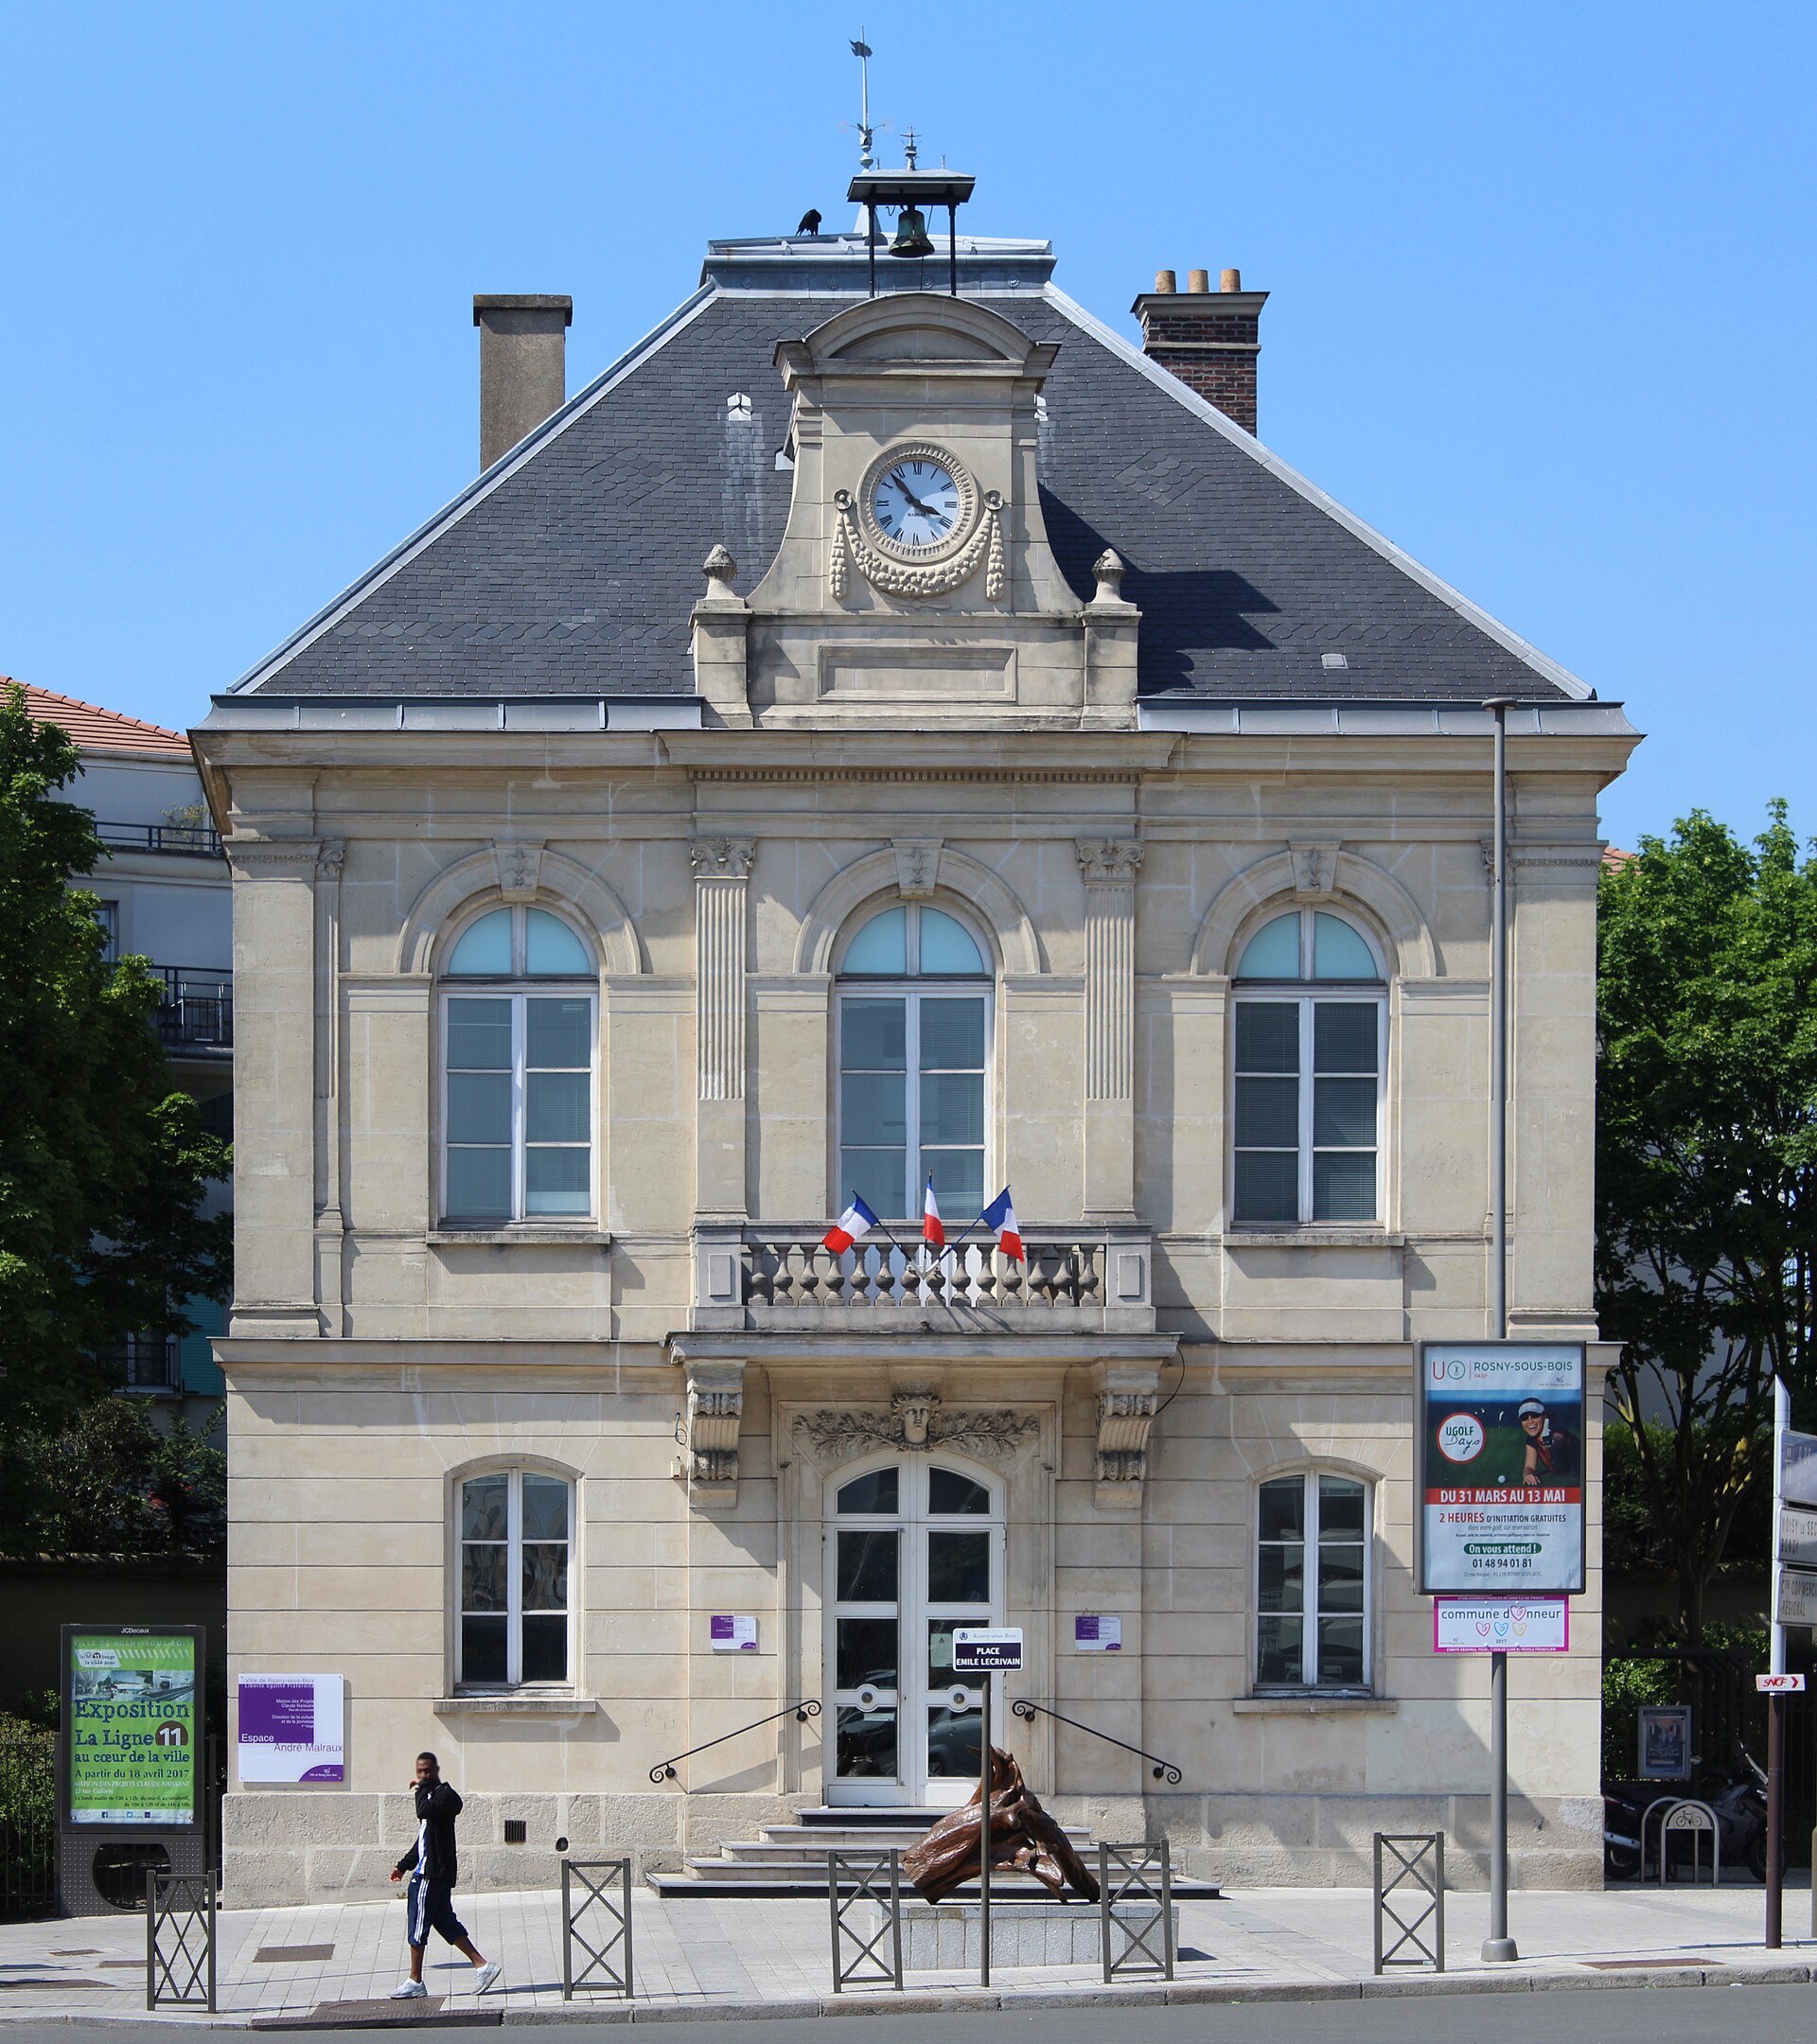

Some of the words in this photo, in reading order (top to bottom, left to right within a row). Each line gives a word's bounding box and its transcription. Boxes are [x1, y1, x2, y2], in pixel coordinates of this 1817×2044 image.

[1473, 1362, 1573, 1371] ROSNY-SOUS-BOIS
[1446, 1426, 1474, 1436] UGOLF
[1445, 1435, 1480, 1454] Days
[1440, 1490, 1456, 1503] DU
[1459, 1490, 1473, 1502] 31
[1475, 1490, 1507, 1503] MARS
[1509, 1490, 1525, 1502] AU
[1527, 1490, 1541, 1502] 13
[1544, 1489, 1565, 1502] MAI
[1439, 1513, 1445, 1523] 2
[1448, 1513, 1484, 1523] HEURES
[1487, 1514, 1529, 1523] D'INITIATION
[1530, 1514, 1566, 1523] GRATUITES
[1469, 1544, 1481, 1554] On
[1482, 1545, 1501, 1554] vous
[1503, 1544, 1531, 1554] attend
[1473, 1559, 1483, 1568] 01
[1485, 1559, 1495, 1568] 48
[1497, 1559, 1508, 1568] 94
[1509, 1559, 1520, 1568] 01
[1522, 1559, 1532, 1568] 81
[1441, 1611, 1499, 1619] commune
[1763, 1677, 1787, 1686] SNCF
[75, 1699, 190, 1722] Exposition
[75, 1730, 97, 1746] La
[102, 1729, 154, 1750] Ligne
[159, 1727, 182, 1746] 11
[241, 1734, 274, 1742] Espace
[273, 1743, 303, 1753] André
[305, 1743, 344, 1753] Malraux
[75, 1753, 90, 1763] au
[94, 1753, 126, 1763] cœur
[129, 1751, 146, 1763] de
[148, 1751, 160, 1763] la
[163, 1751, 190, 1763] ville
[75, 1770, 81, 1778] A
[85, 1769, 111, 1780] partir
[114, 1769, 126, 1778] du
[130, 1770, 140, 1778] 18
[143, 1769, 164, 1778] avril
[167, 1770, 189, 1778] 2017
